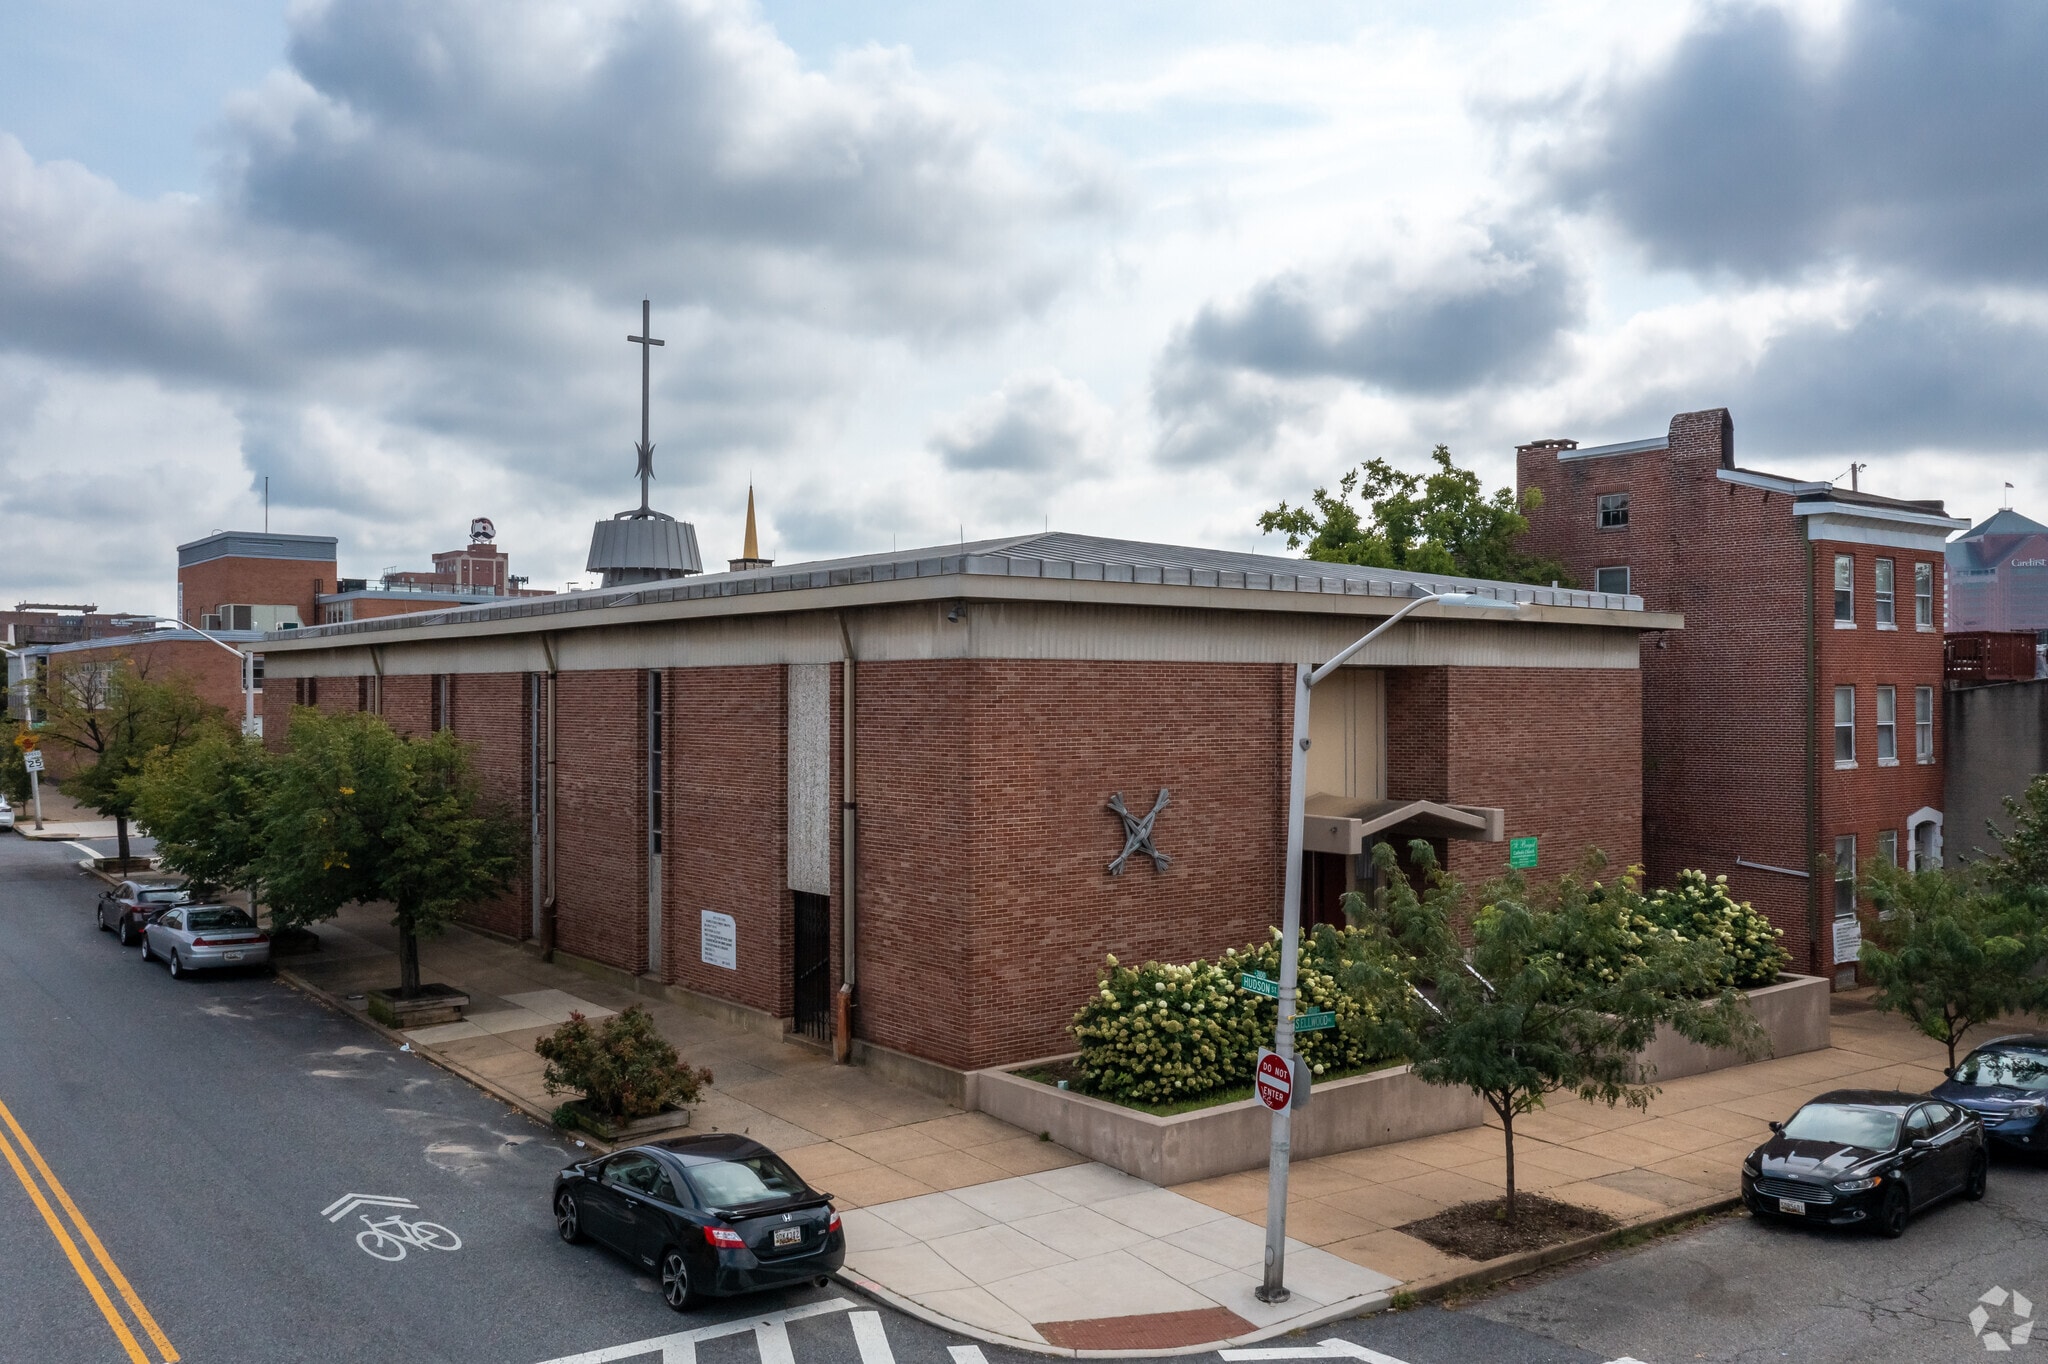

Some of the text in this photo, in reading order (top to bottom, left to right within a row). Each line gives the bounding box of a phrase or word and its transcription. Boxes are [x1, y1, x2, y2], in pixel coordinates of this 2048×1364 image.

[28, 759, 42, 768] 25
[1243, 976, 1270, 993] HUDSON
[1262, 1062, 1287, 1079] DO NOT
[1263, 1086, 1284, 1102] ENTER
